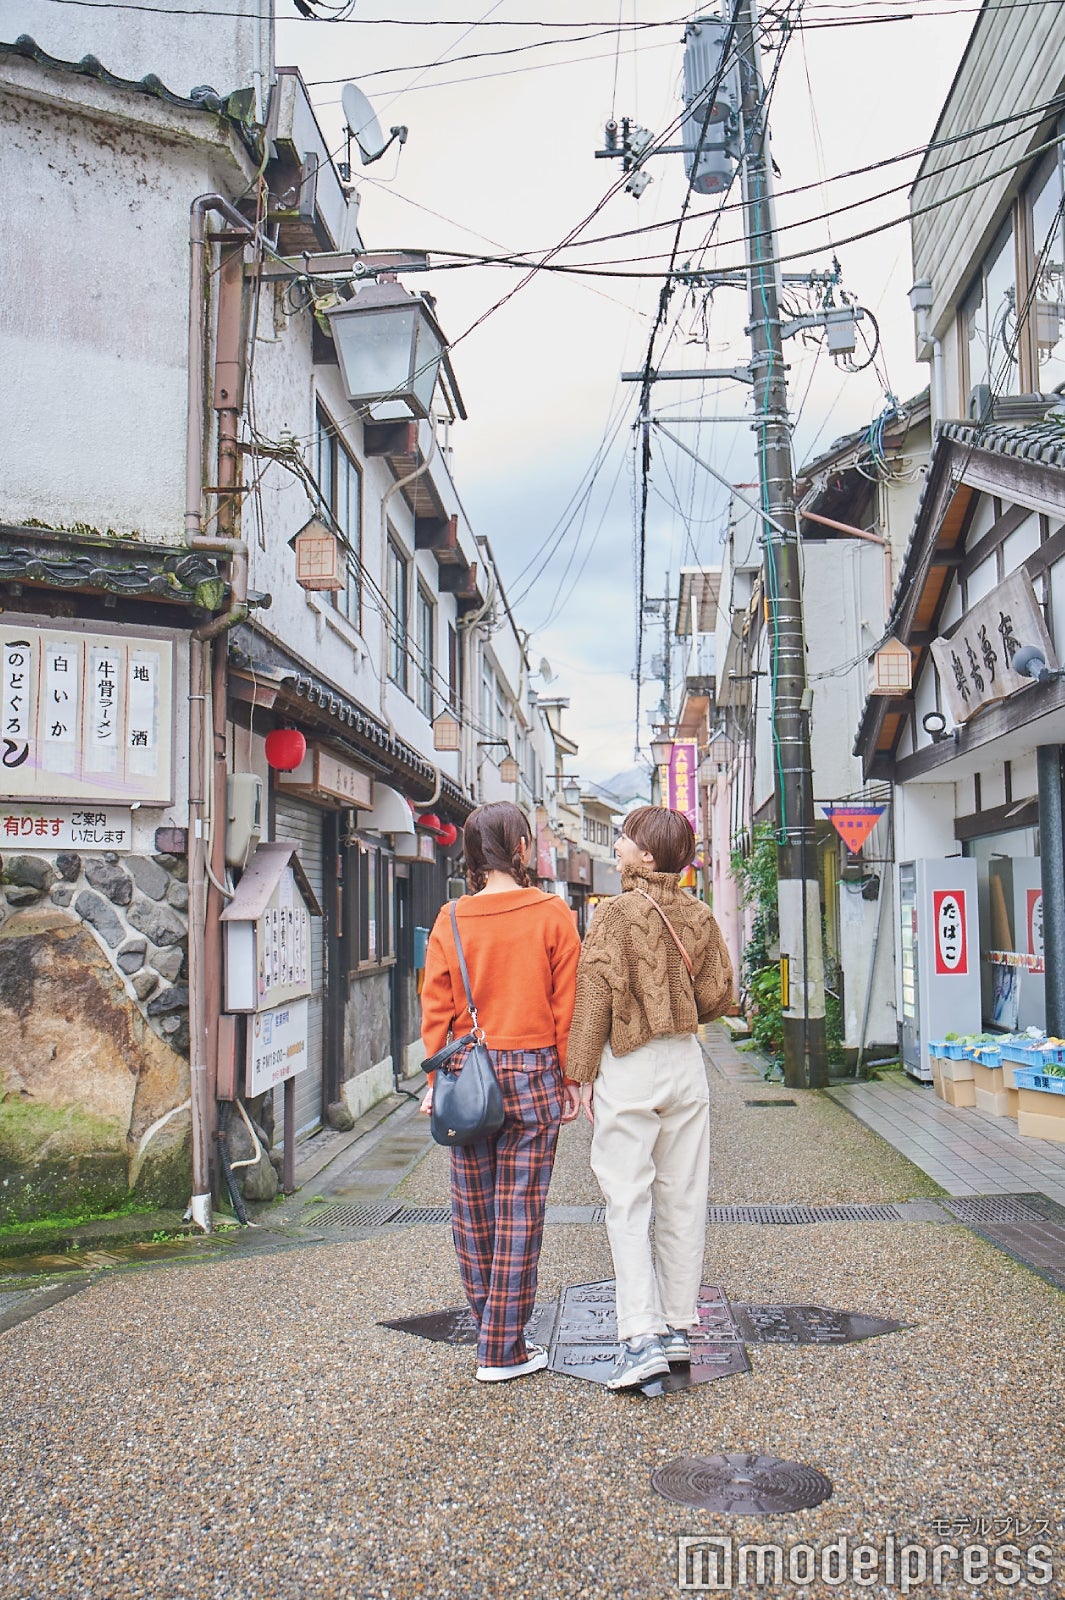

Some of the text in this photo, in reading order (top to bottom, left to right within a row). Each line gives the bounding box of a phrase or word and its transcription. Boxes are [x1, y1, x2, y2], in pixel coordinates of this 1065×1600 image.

[7, 652, 25, 734] のどぐろ
[51, 655, 69, 737] 白いか
[97, 661, 115, 739] 牛骨ラーメン
[131, 665, 150, 747] 地酒
[3, 815, 65, 837] 有ります
[71, 811, 107, 827] ご案内
[71, 829, 126, 844] いたします
[942, 902, 960, 961] たばこ
